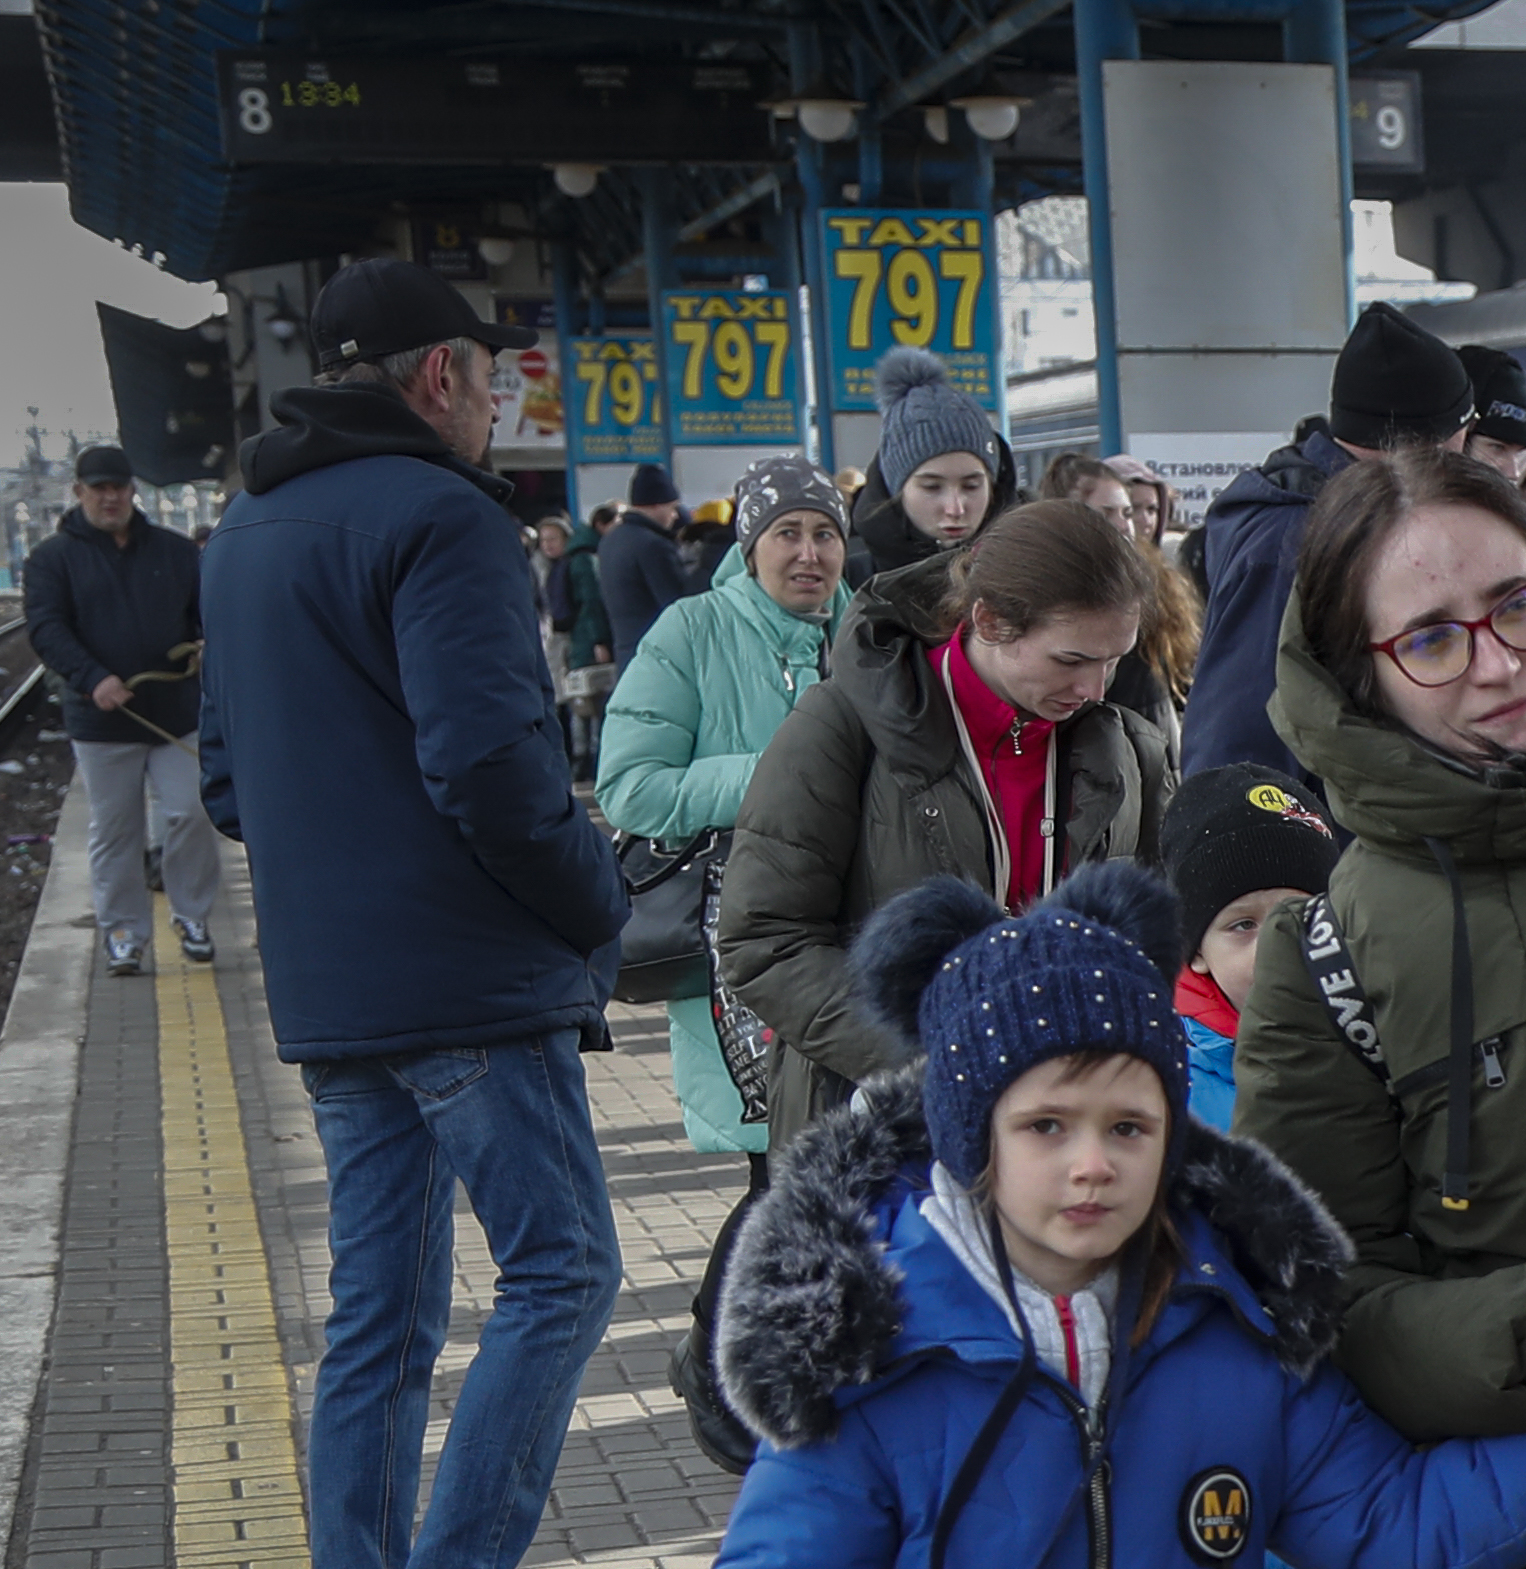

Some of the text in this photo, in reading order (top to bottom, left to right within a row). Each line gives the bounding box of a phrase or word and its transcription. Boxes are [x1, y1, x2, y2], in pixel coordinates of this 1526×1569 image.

[238, 87, 273, 135] 8
[1376, 105, 1406, 151] 9
[828, 217, 982, 247] TAXI
[667, 296, 788, 319] TAXI
[835, 249, 984, 350] 797
[671, 320, 790, 399] 797
